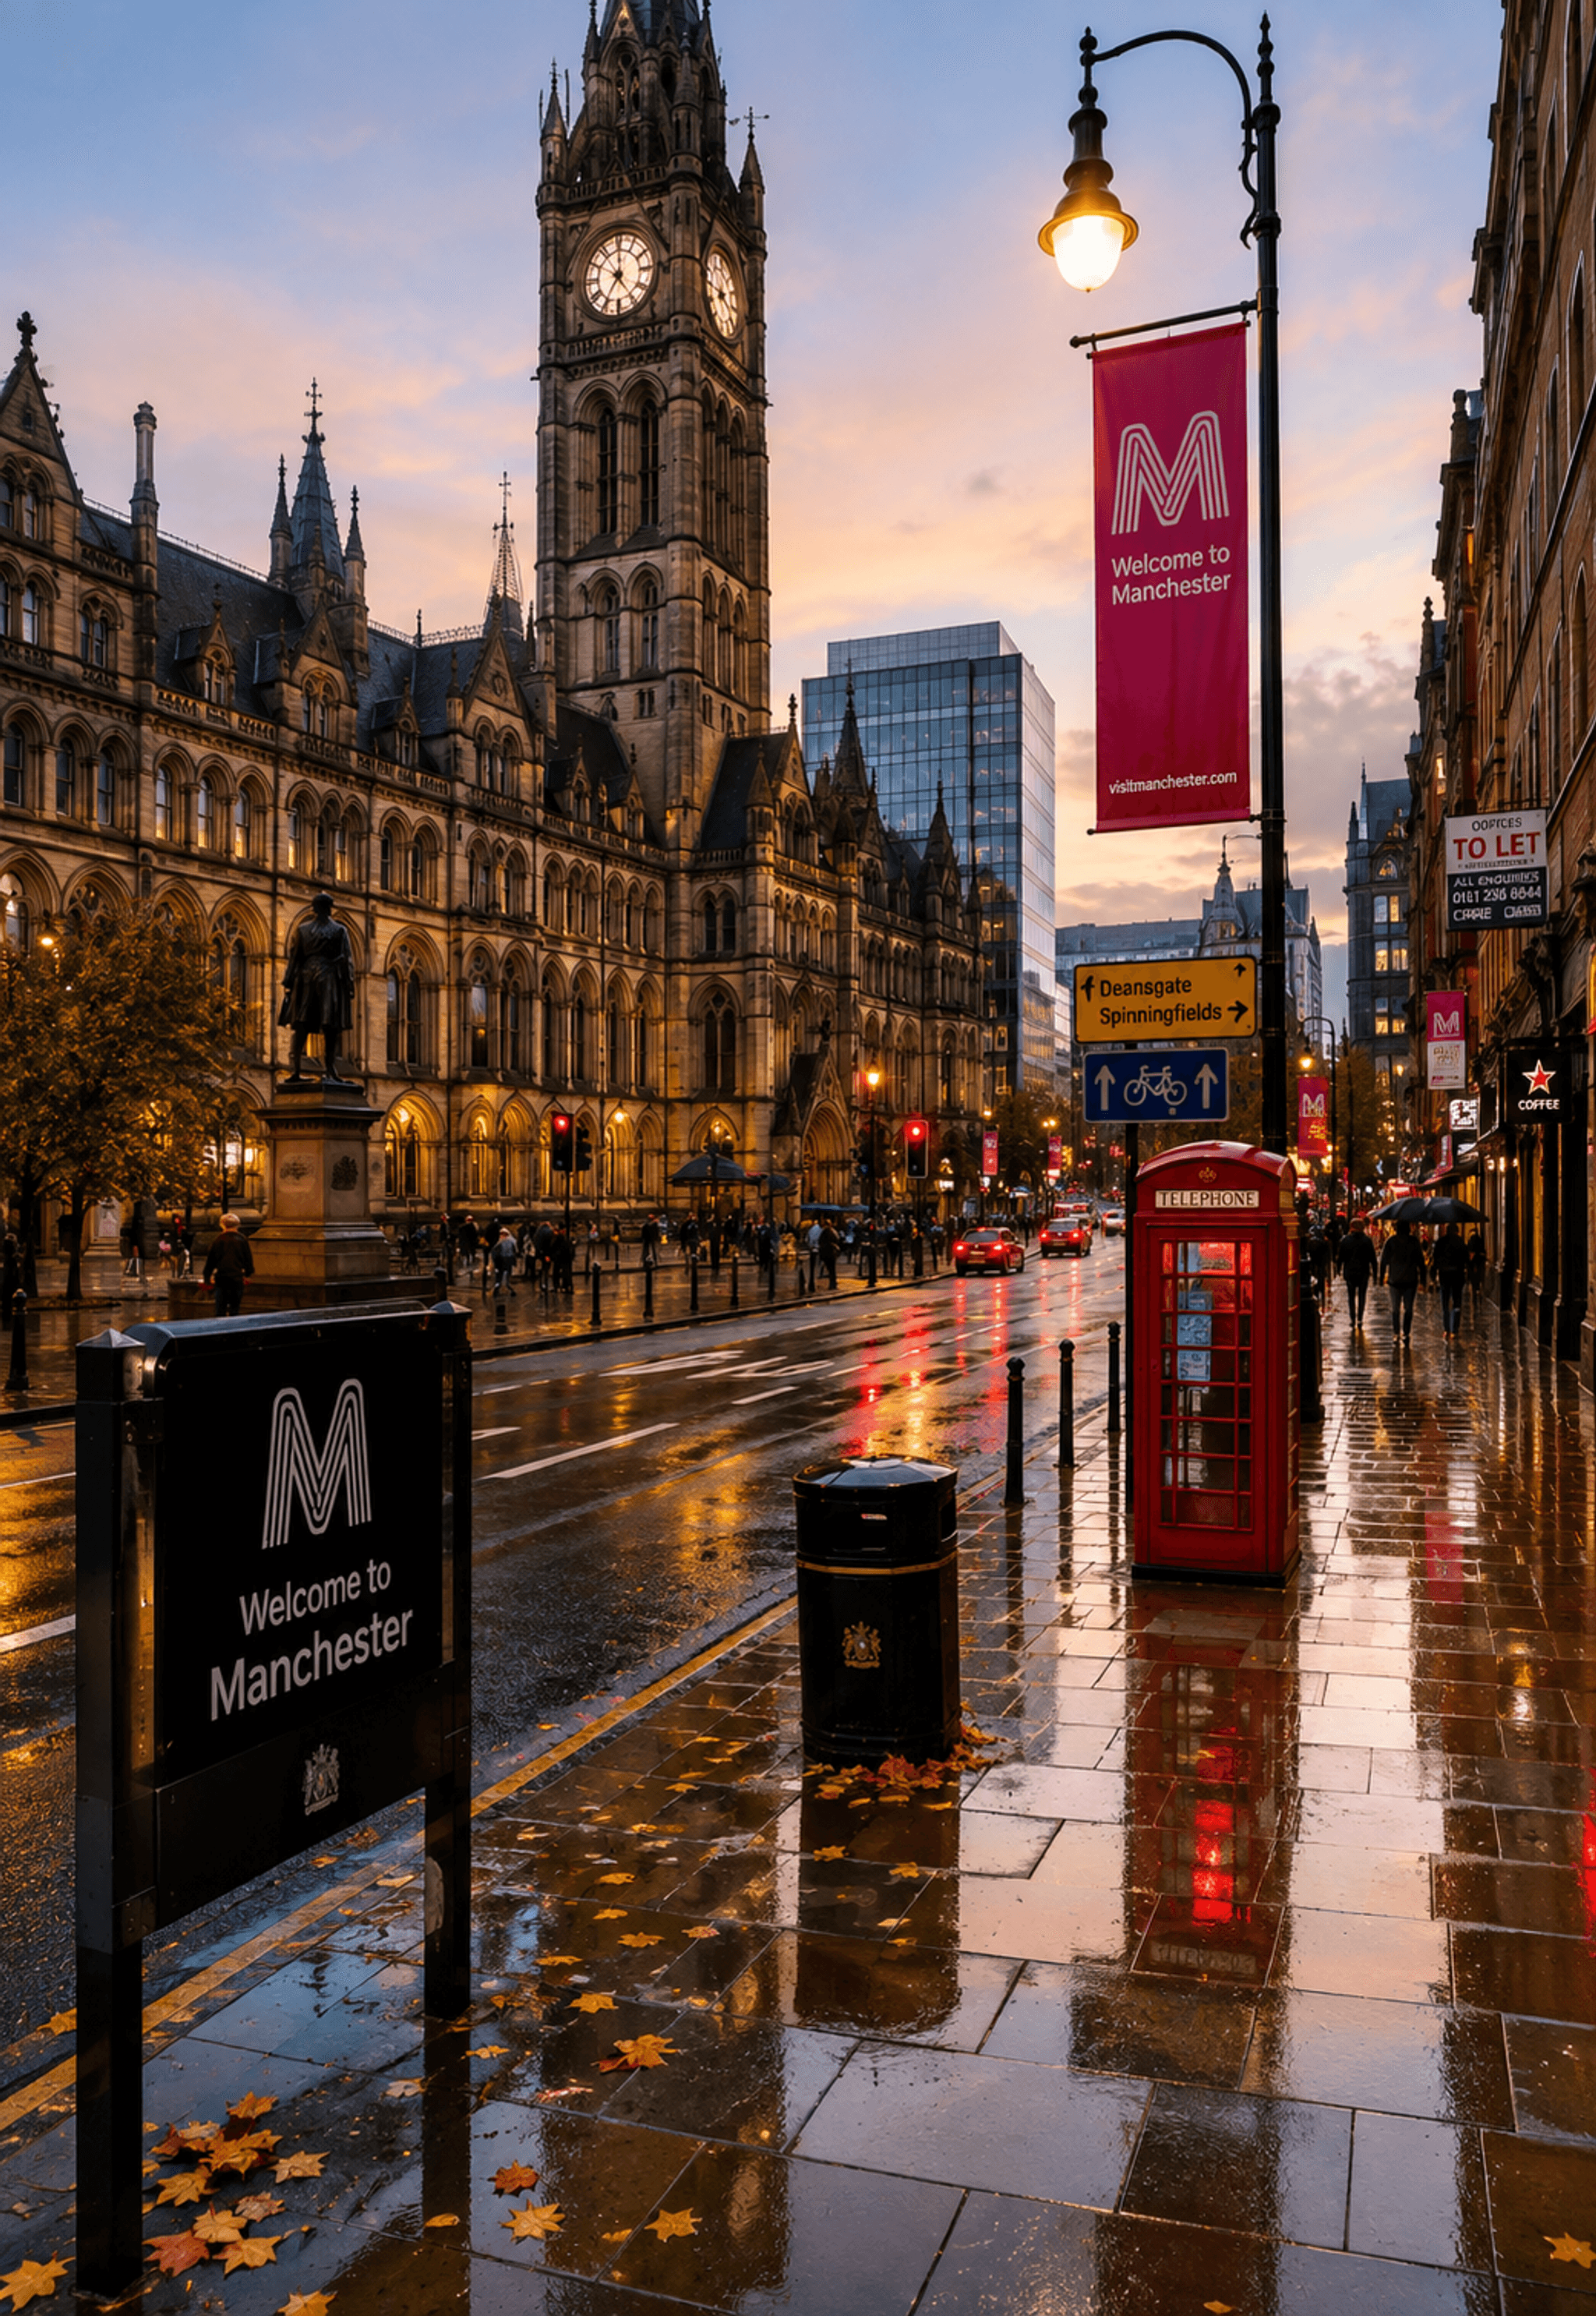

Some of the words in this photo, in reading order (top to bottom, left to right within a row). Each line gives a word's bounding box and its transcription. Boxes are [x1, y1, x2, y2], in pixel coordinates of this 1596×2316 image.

[1111, 550, 1203, 578] Welcome
[1208, 544, 1231, 564] to
[1112, 572, 1231, 606] Manchester
[1109, 772, 1237, 794] visitmanchester.com
[1453, 836, 1487, 861] TO
[1495, 831, 1541, 857] LET
[1100, 977, 1192, 999] Deansgate
[1100, 1002, 1222, 1029] Spinningfields
[1517, 1099, 1560, 1111] COFFEE
[1159, 1191, 1255, 1206] TELEPHONE
[239, 1571, 361, 1635] Welcome
[366, 1559, 390, 1593] to
[211, 1609, 413, 1721] Manchester
